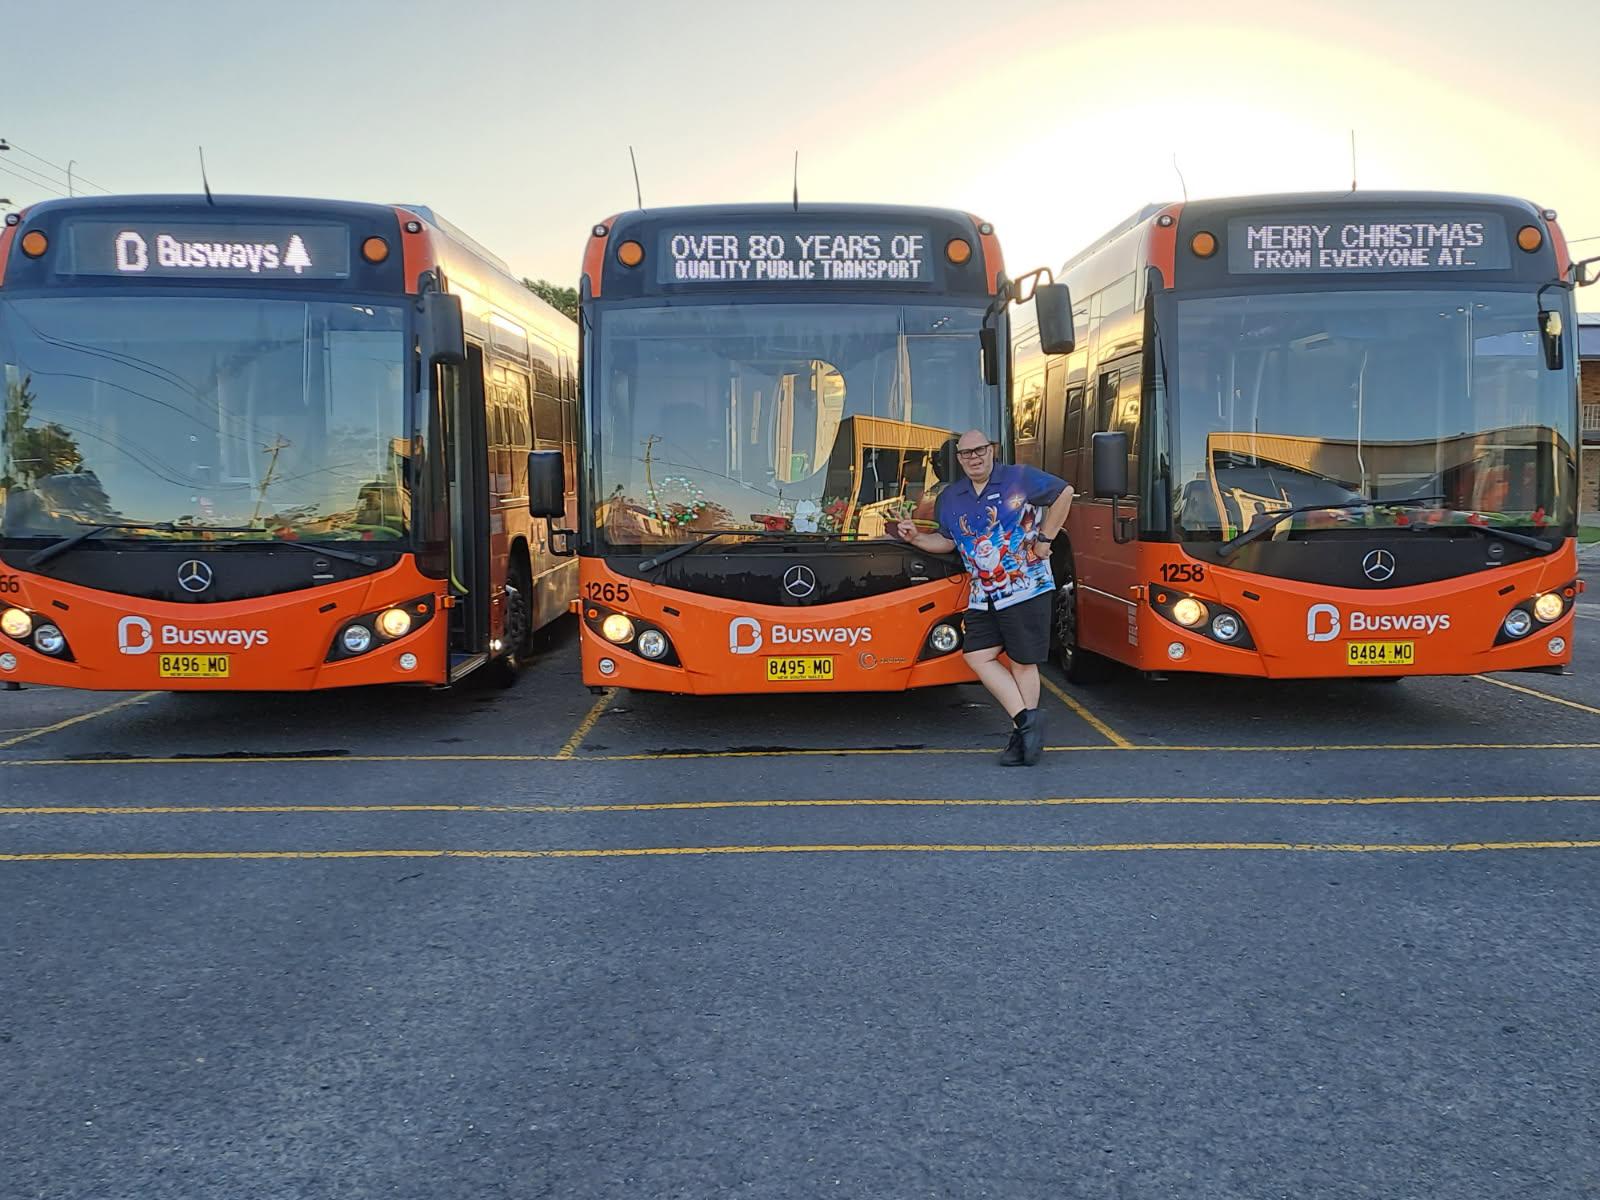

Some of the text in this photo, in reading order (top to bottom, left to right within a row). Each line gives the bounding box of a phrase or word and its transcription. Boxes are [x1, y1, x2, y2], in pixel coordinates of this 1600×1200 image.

[1247, 223, 1484, 249] MERRY CHRISTMAS
[156, 234, 280, 273] Busways
[671, 235, 923, 260] OVER 80 YEARS OF
[1253, 251, 1311, 268] FROM
[1319, 249, 1430, 268] EVERYONE
[675, 260, 921, 280] QUALITY PUBLIC TRANSPORT
[1160, 563, 1204, 582] 1258
[585, 582, 629, 602] 1265
[1350, 611, 1451, 634] Busways
[162, 626, 269, 650] Busways
[771, 625, 872, 647] Busways
